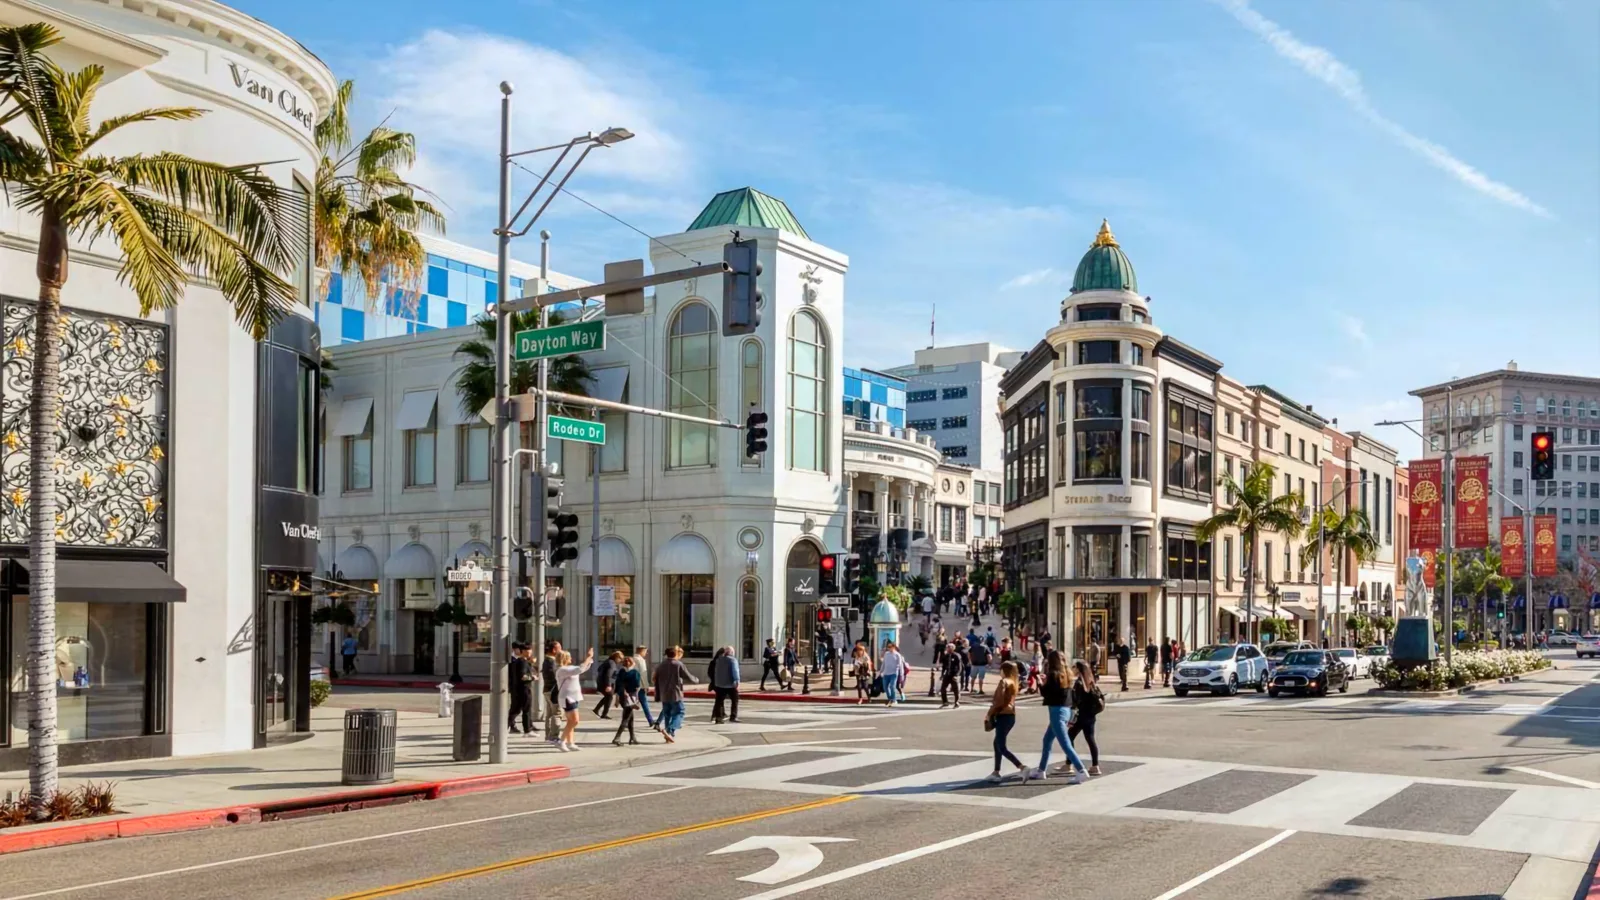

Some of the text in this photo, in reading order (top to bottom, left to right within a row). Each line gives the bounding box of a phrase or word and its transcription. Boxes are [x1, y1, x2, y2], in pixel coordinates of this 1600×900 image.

[228, 62, 273, 103] Van
[521, 330, 597, 354] Dayton Way
[553, 421, 600, 438] Rodeo Dr
[281, 521, 300, 538] Van
[450, 572, 472, 580] RODEO
